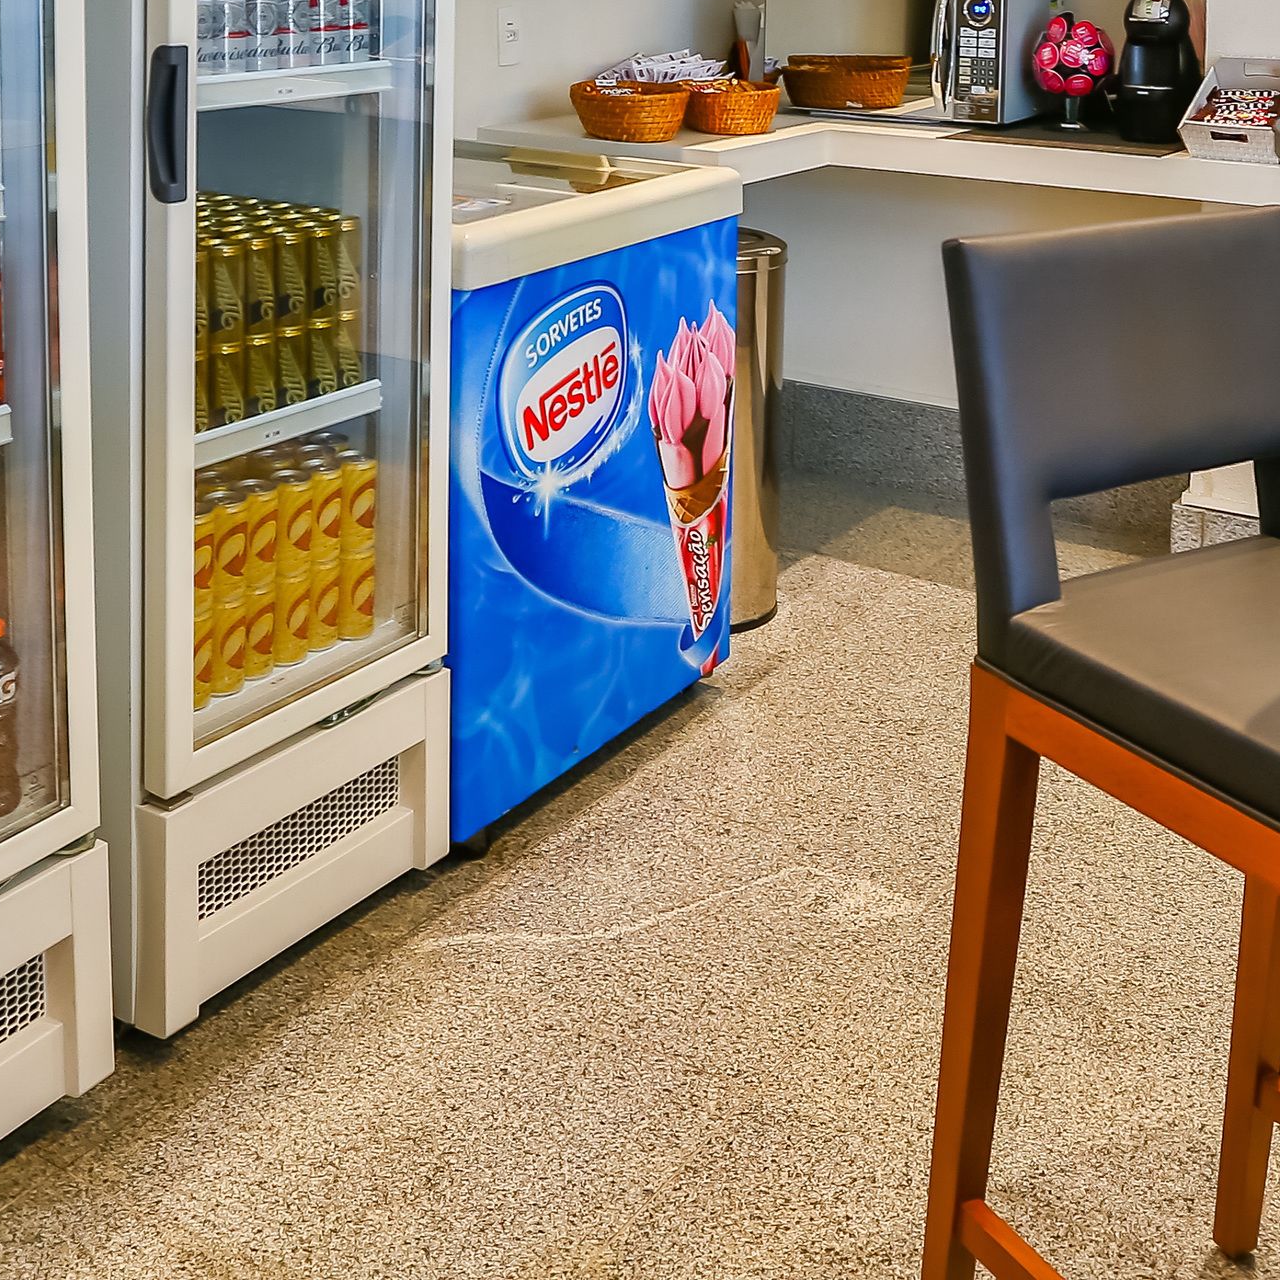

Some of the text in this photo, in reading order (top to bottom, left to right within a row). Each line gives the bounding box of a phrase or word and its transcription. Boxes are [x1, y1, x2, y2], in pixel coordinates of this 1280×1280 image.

[525, 298, 602, 368] SORVETES
[523, 341, 619, 451] Nestlé
[688, 530, 713, 632] Sensação
